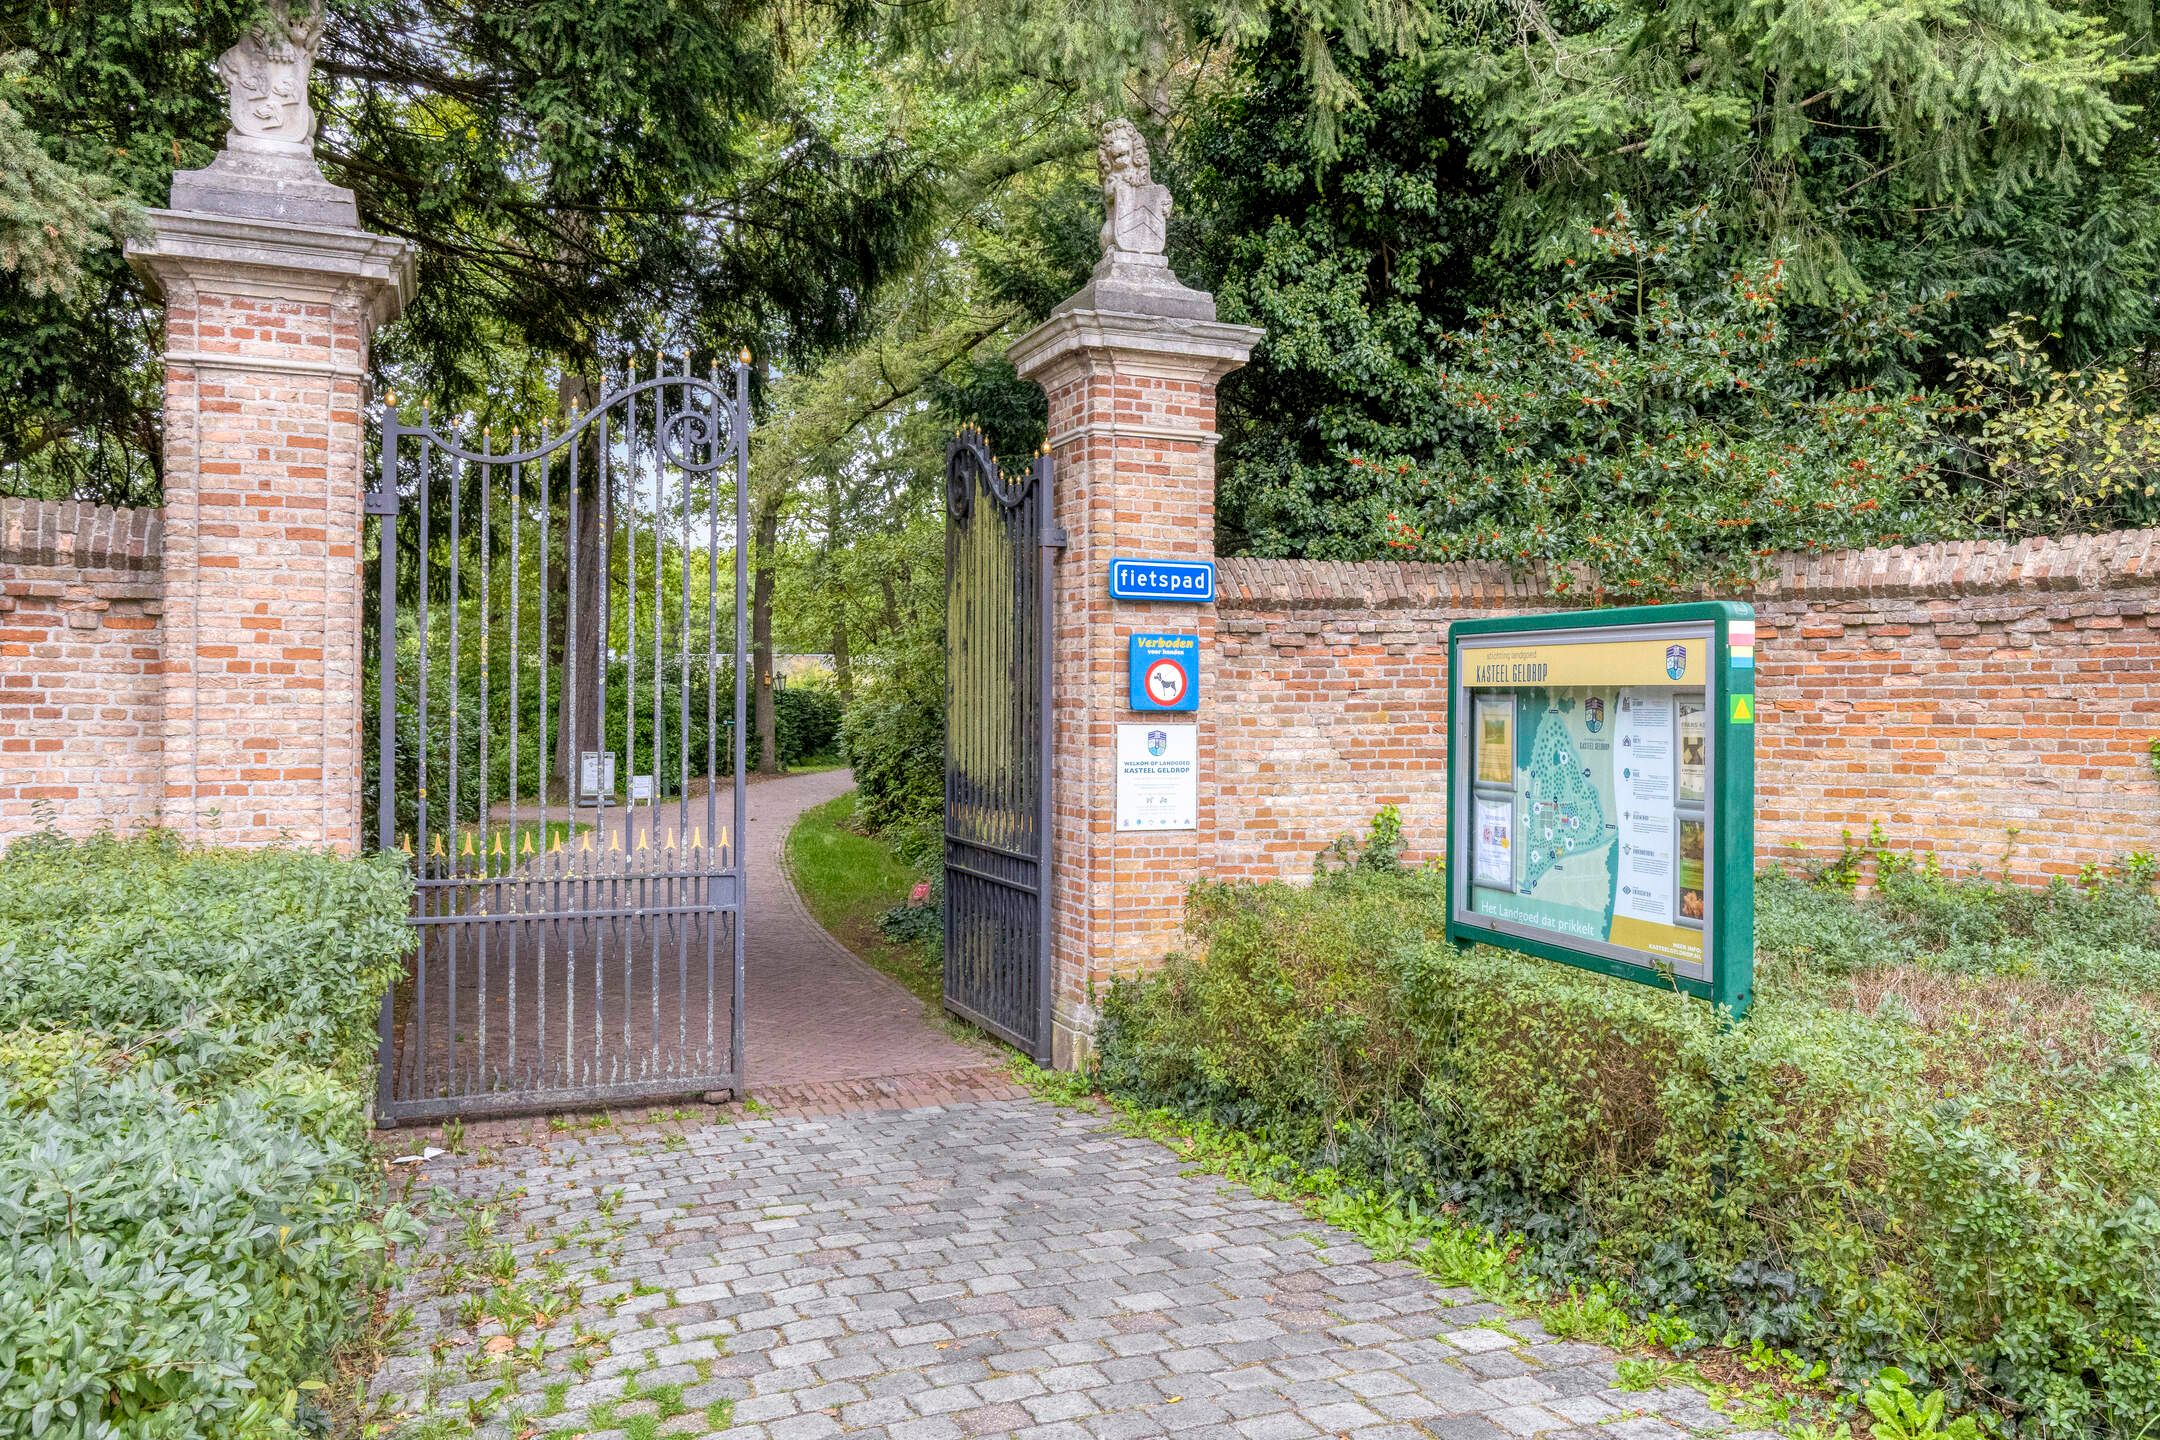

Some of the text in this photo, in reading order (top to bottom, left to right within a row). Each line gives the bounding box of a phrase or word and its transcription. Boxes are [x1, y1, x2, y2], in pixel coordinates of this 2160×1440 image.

[1120, 569, 1205, 591] fietspad
[1137, 637, 1194, 648] Verboden
[1476, 663, 1548, 682] KASTEEL GELDROP
[1481, 900, 1594, 937] Het Landgoed dat prikkelt
